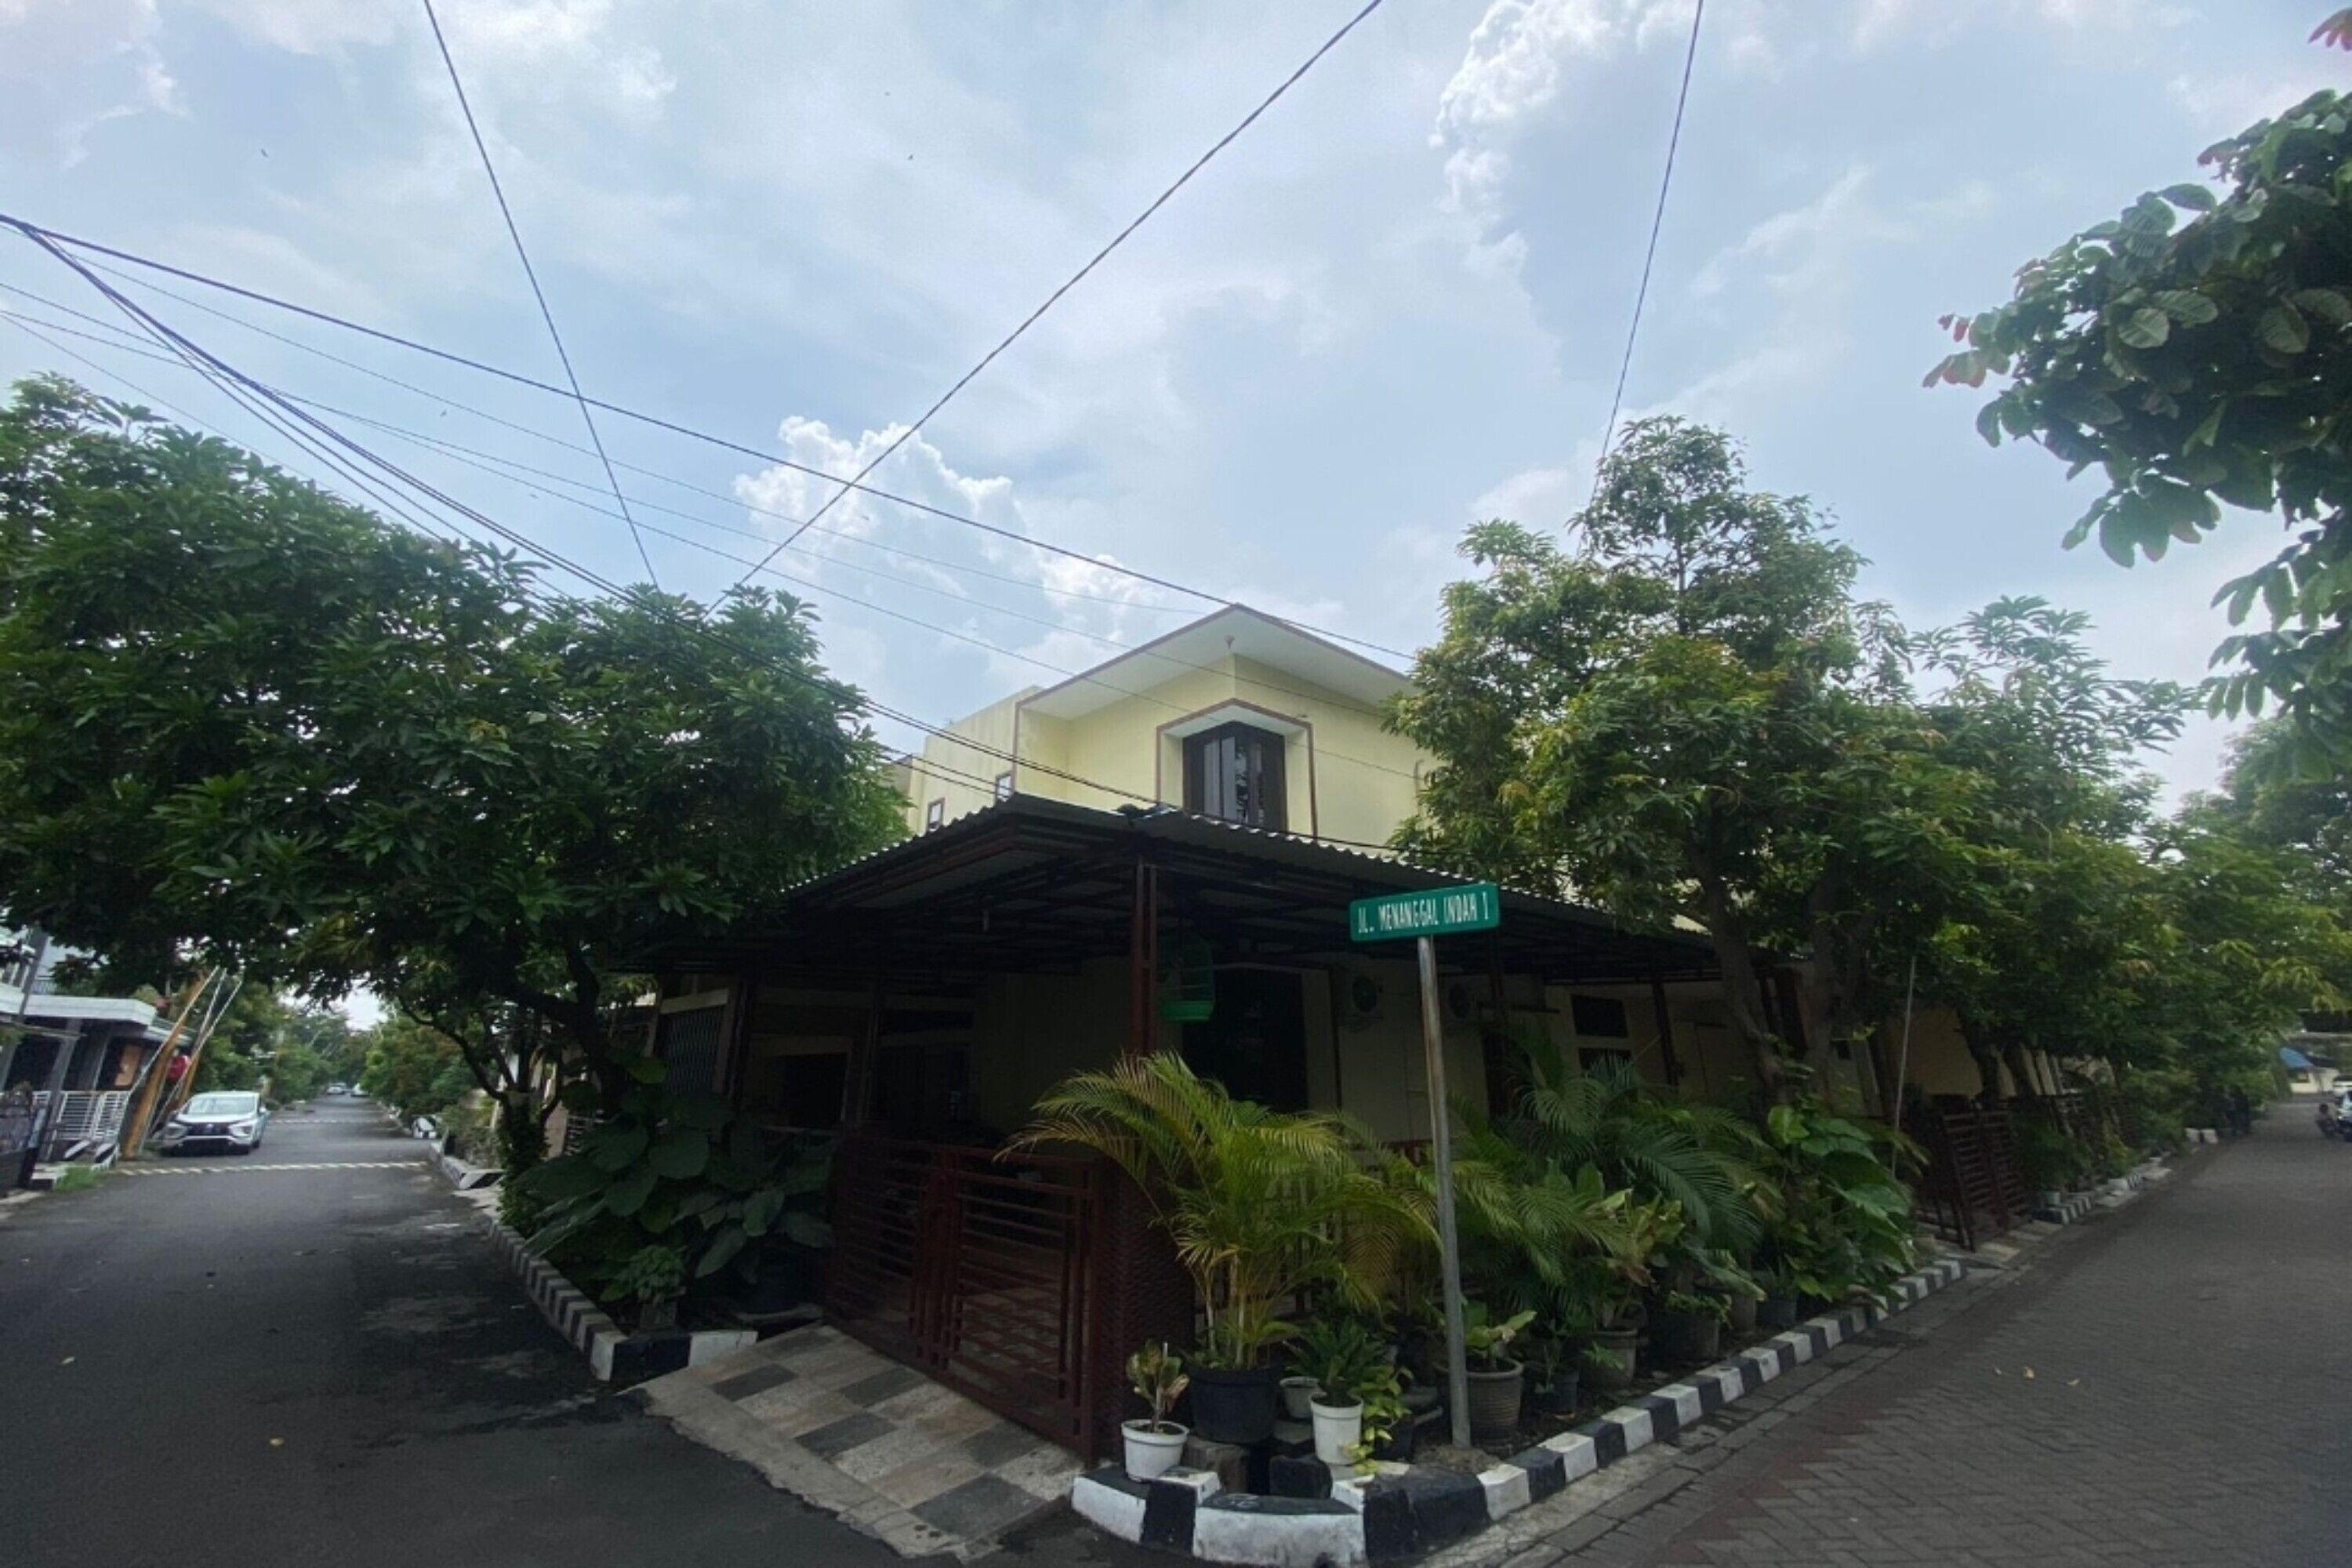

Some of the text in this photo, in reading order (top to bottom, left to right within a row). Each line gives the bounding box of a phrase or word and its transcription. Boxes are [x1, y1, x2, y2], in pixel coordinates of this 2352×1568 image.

[1358, 906, 1374, 934] JL.
[1377, 898, 1439, 931] MENANGGAL
[1443, 893, 1478, 924] INDAH
